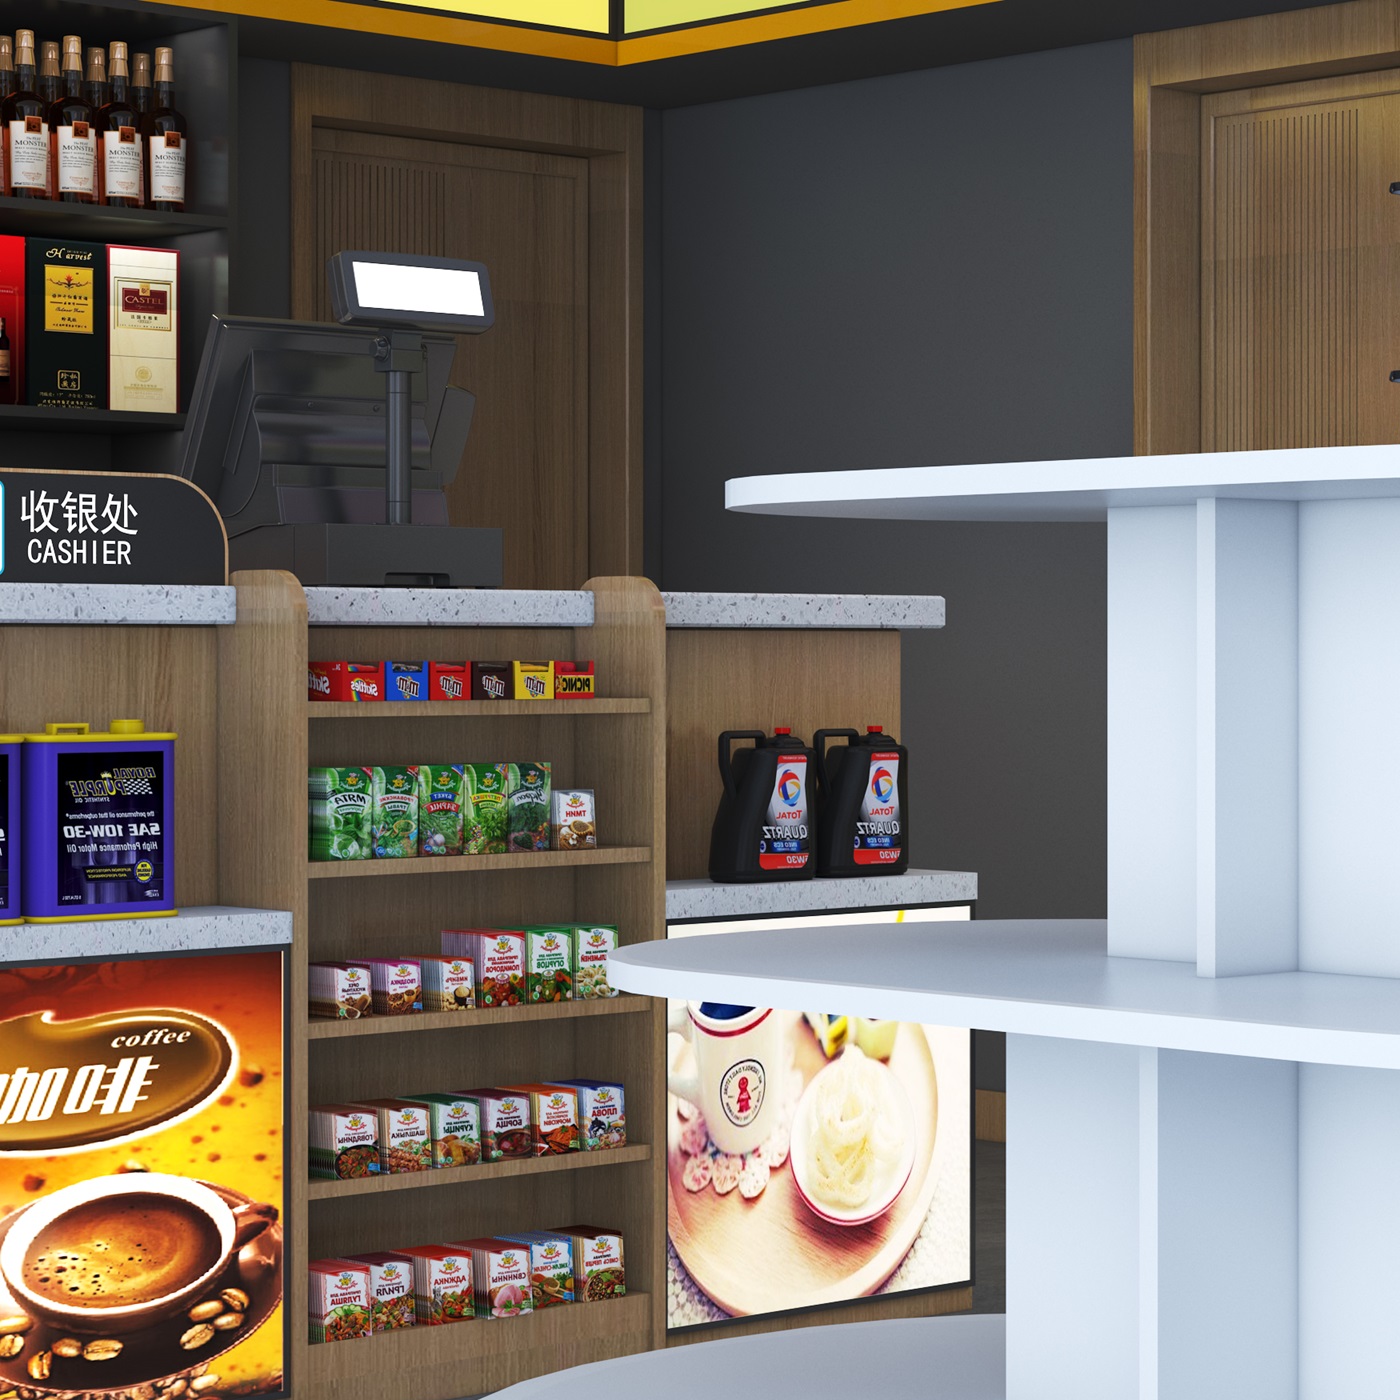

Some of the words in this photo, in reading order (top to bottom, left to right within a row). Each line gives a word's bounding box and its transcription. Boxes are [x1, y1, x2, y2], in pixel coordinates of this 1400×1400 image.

[20, 489, 139, 535] 收银处
[27, 538, 132, 565] CASHIER
[111, 1028, 191, 1049] coffee
